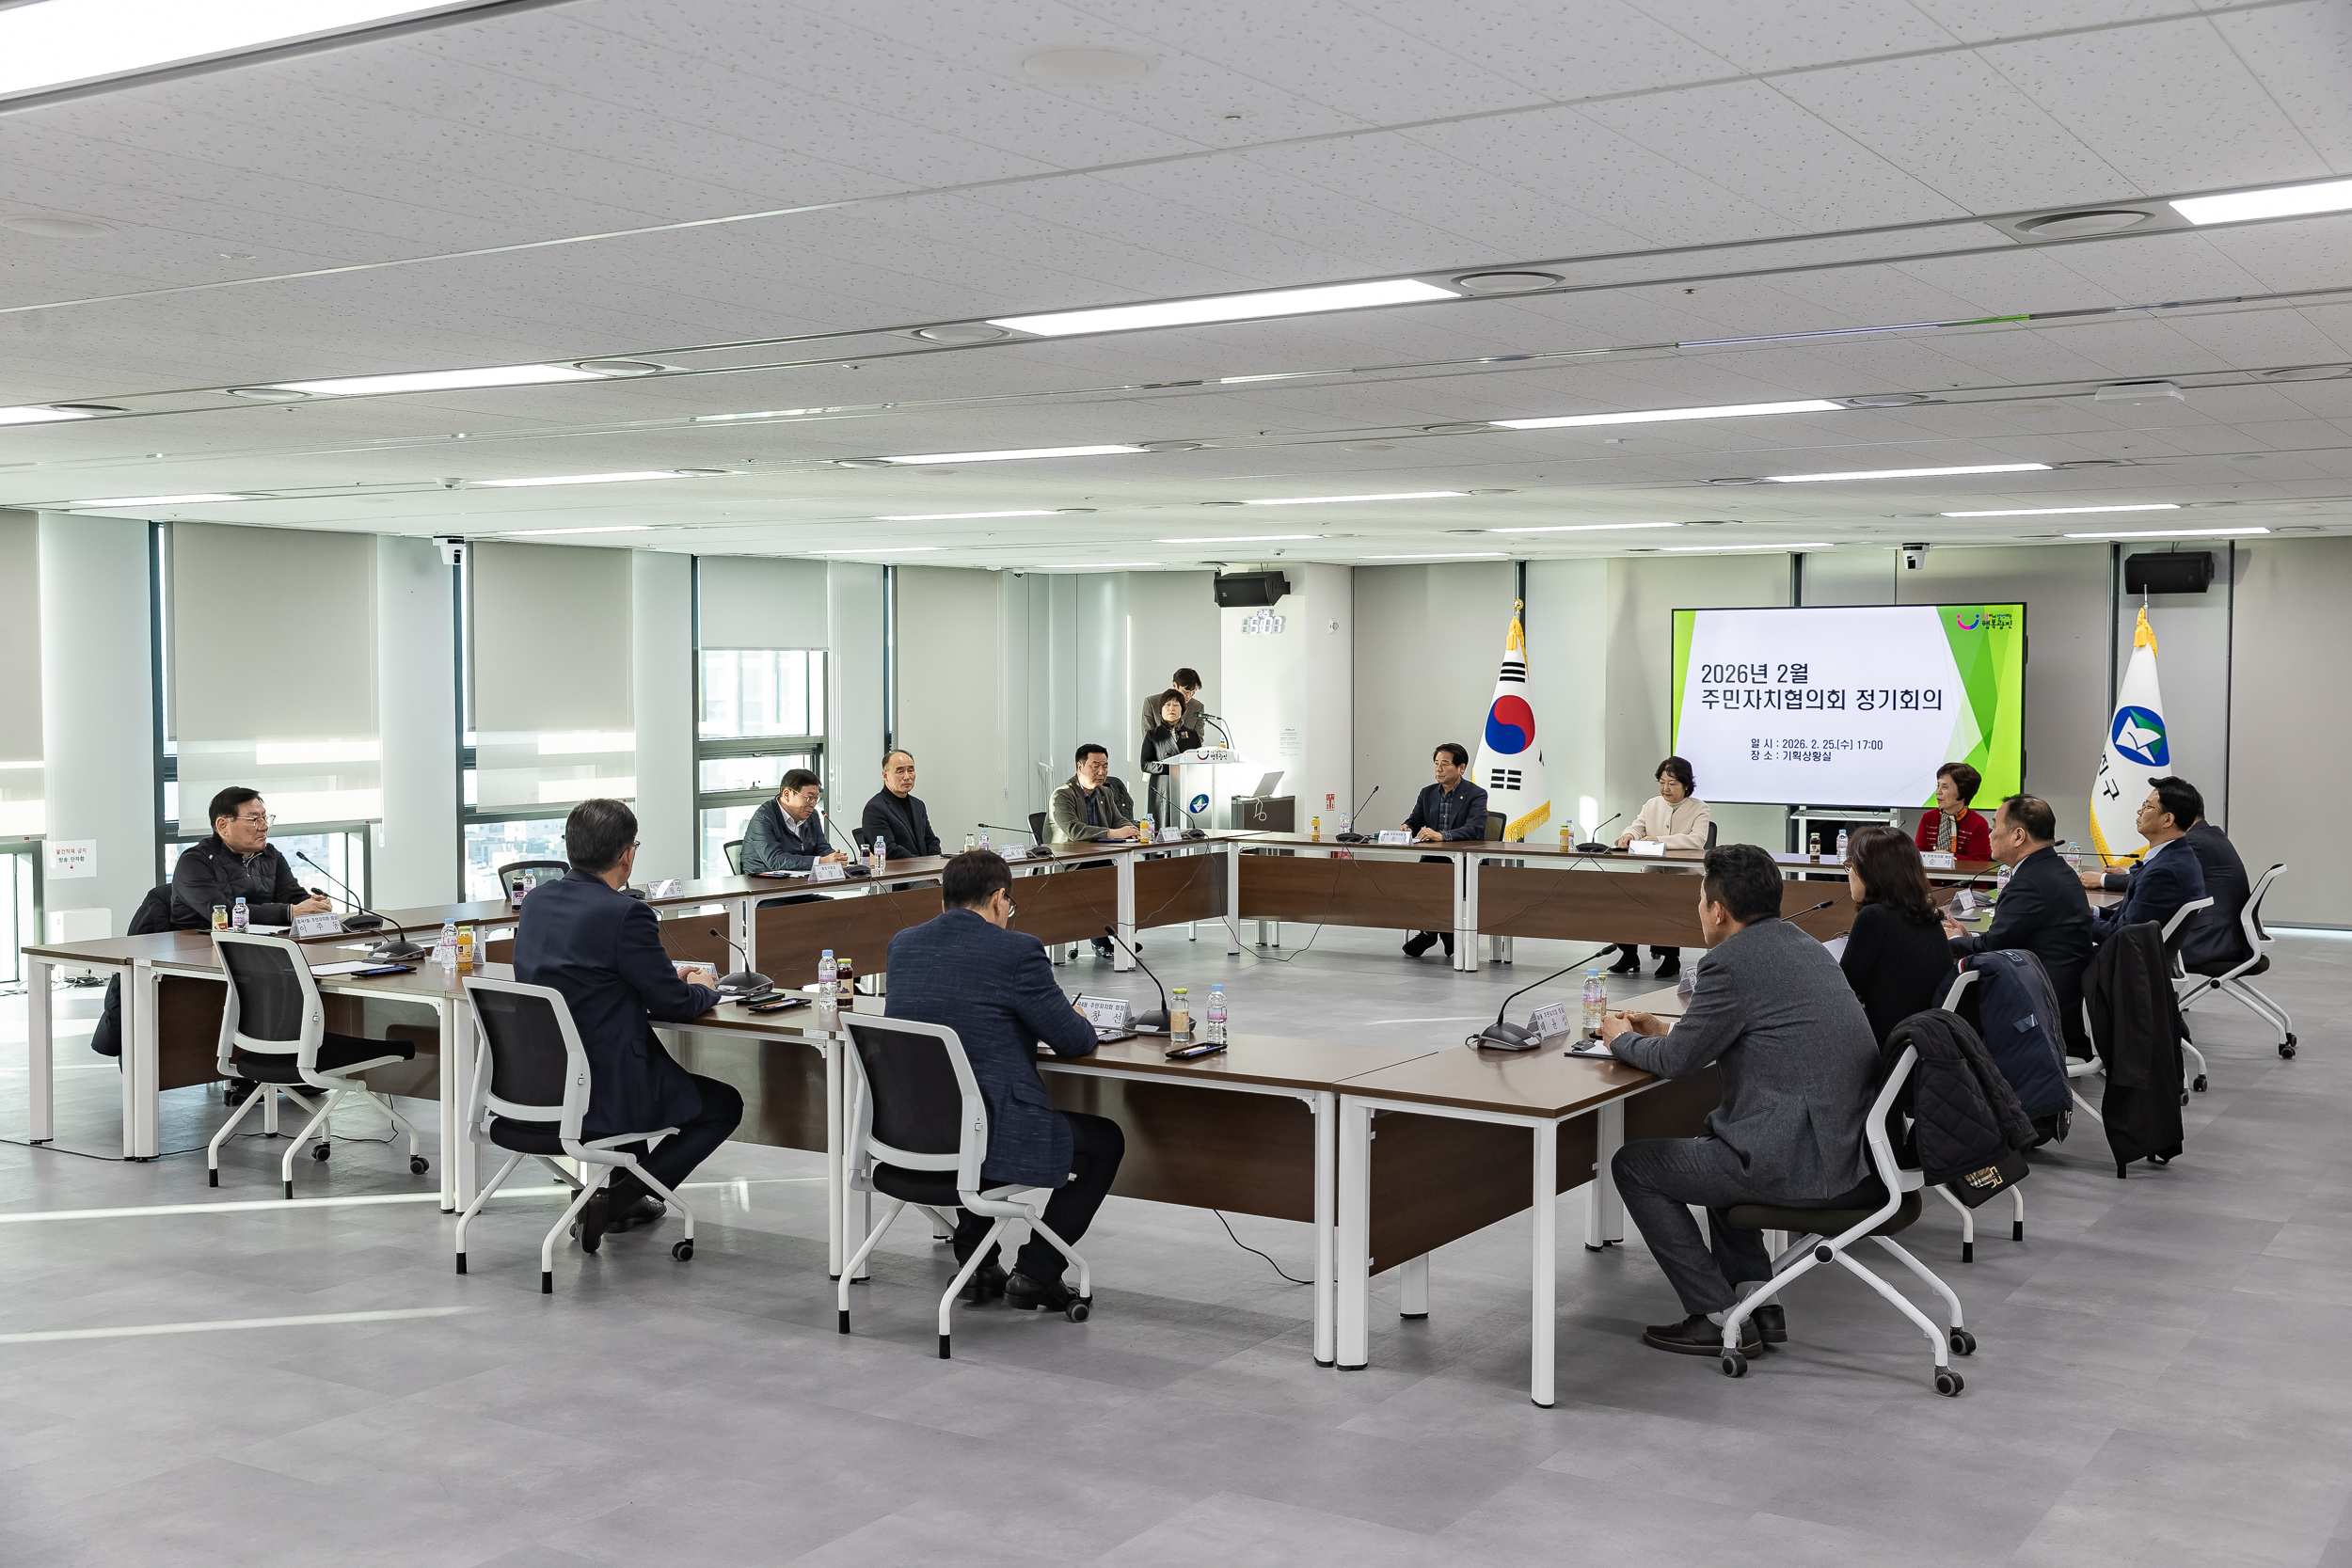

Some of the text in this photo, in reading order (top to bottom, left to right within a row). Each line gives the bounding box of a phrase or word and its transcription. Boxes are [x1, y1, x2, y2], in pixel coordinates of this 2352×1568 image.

[1981, 620, 2012, 629] 행복광진
[1701, 663, 1808, 684] 2026년 2월
[1702, 689, 1942, 711] 주민자치협의회 정기회의
[1782, 738, 1808, 750] 2026.
[1811, 739, 1820, 750] 2.
[1857, 739, 1883, 751] 17:00
[1782, 751, 1832, 762] 기획상황실
[1112, 1012, 1122, 1023] 선
